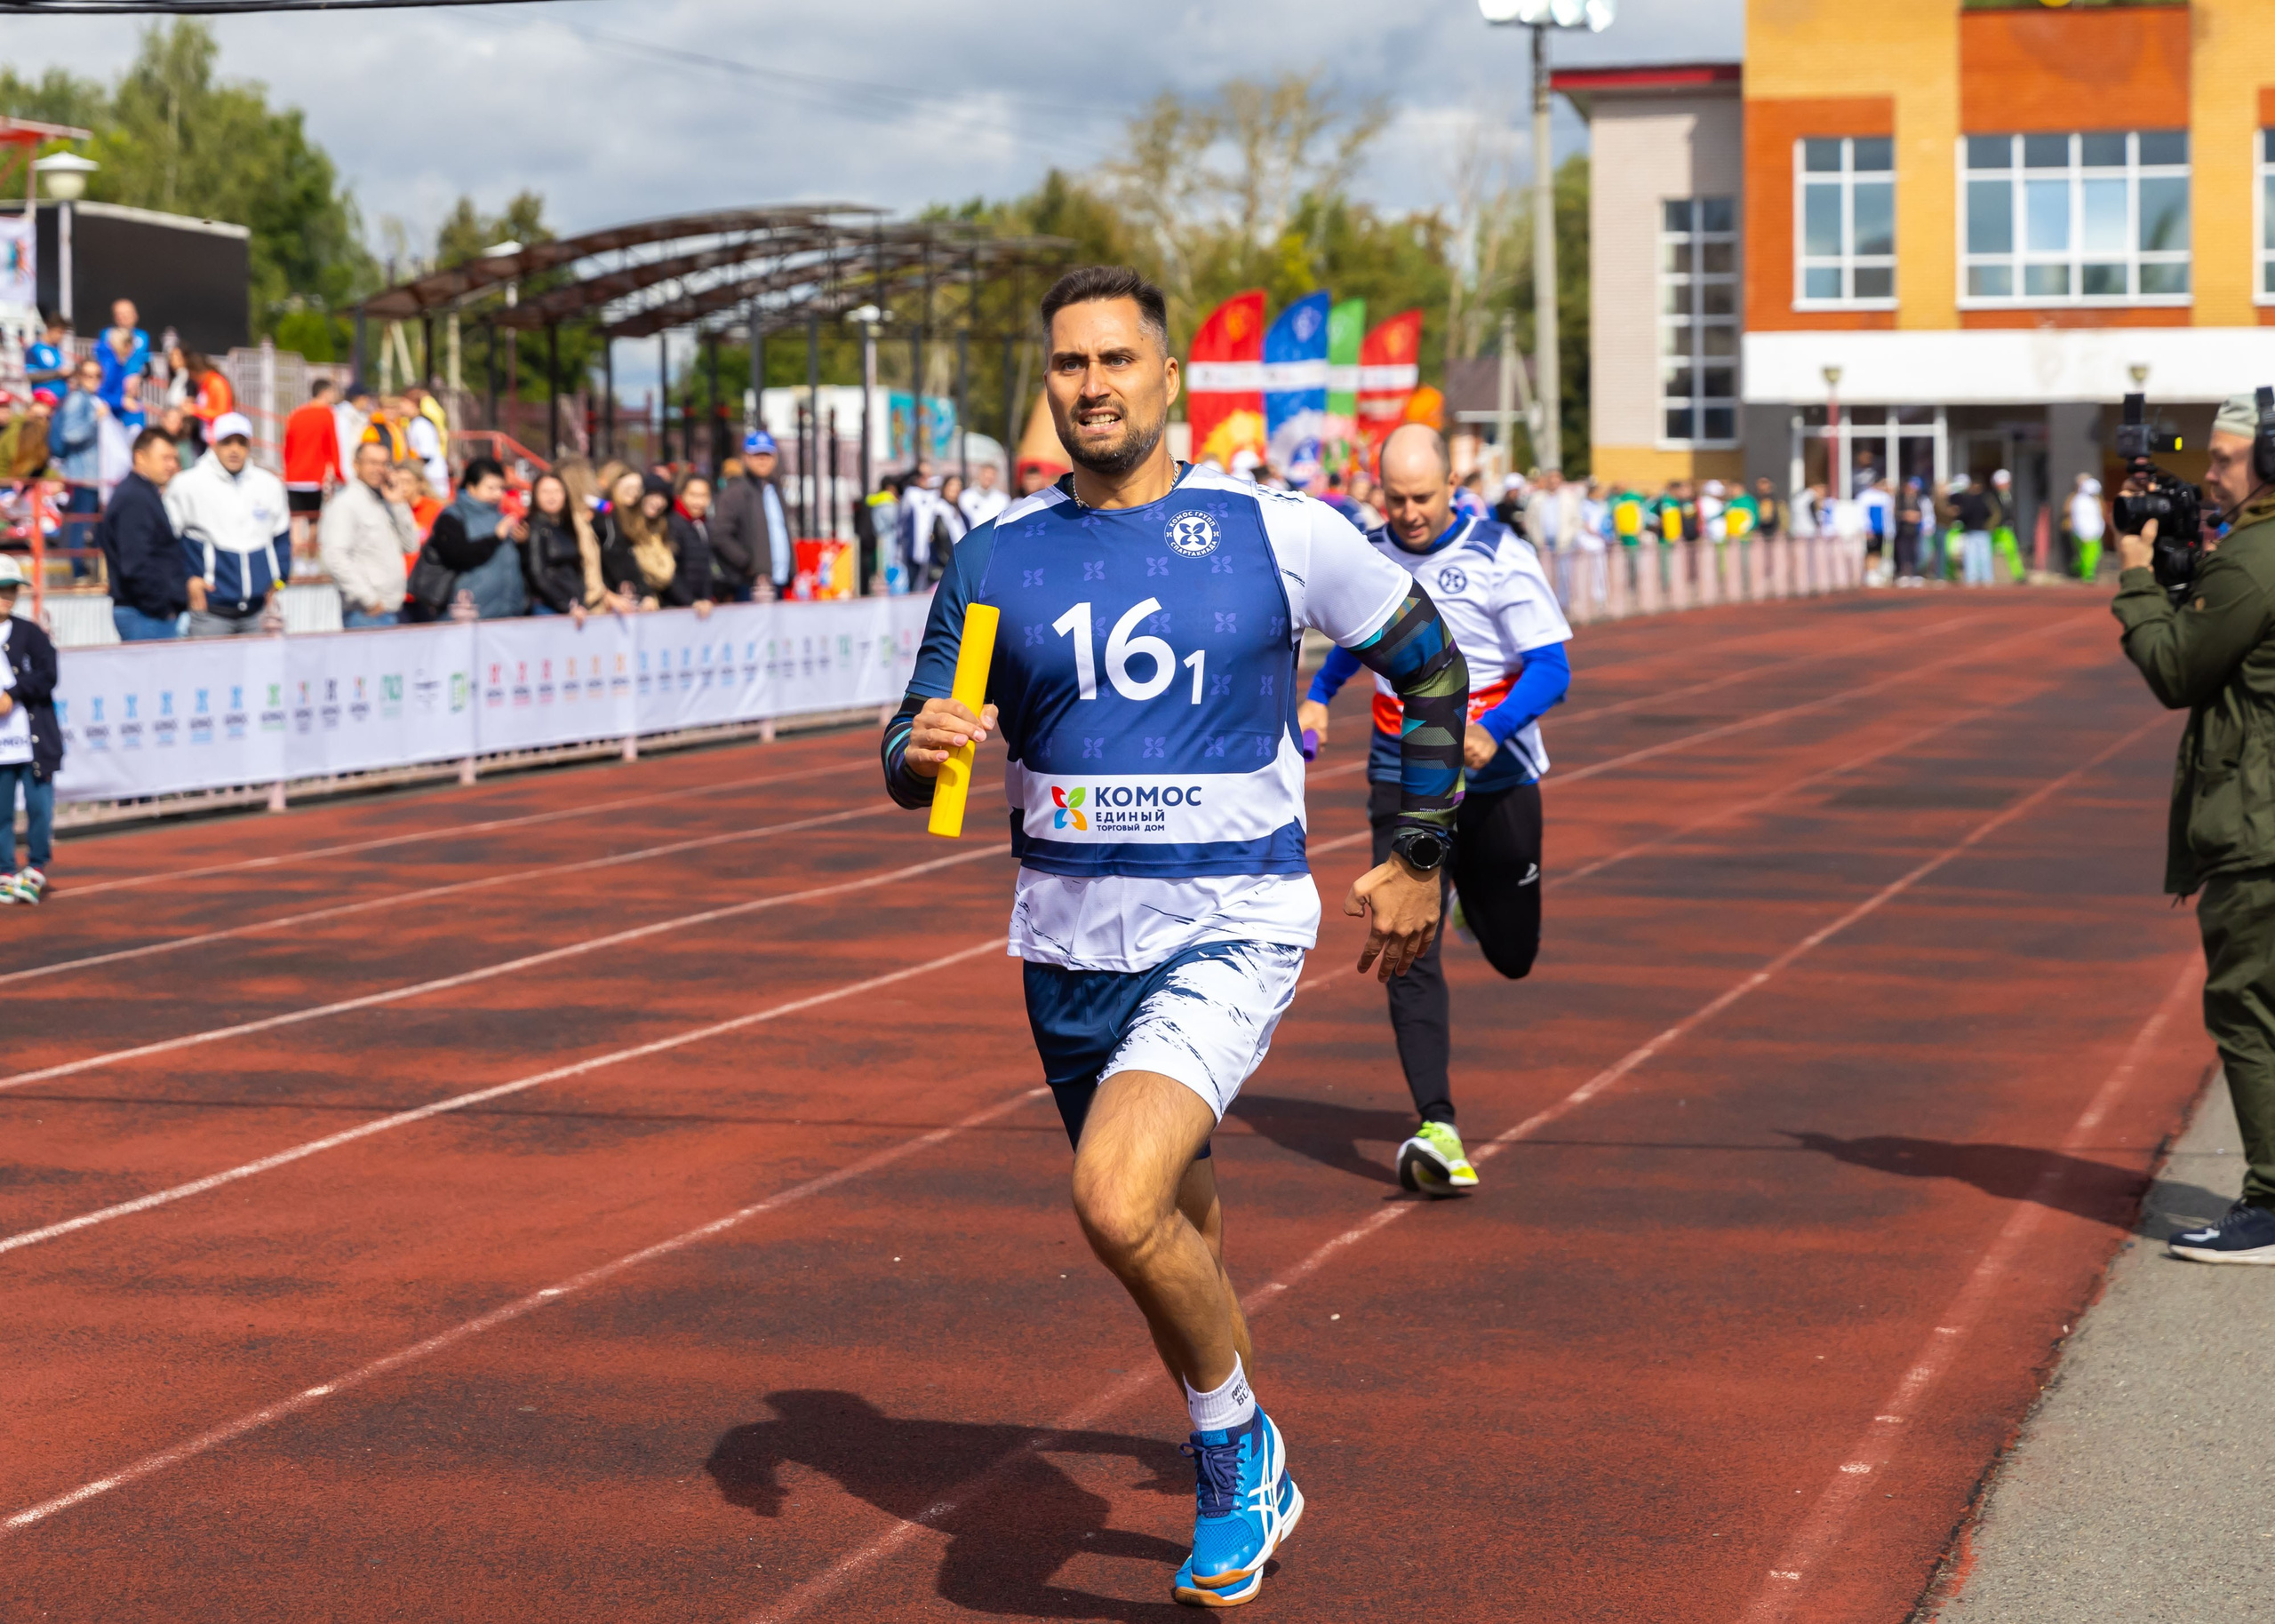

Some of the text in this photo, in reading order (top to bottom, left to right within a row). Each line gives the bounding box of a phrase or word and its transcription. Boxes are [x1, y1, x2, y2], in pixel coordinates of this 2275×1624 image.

[1169, 511, 1216, 528] КОМОС ГРУПП
[1170, 541, 1218, 556] СПАРТАКИАДА
[1095, 786, 1202, 807] КОМОС
[1095, 809, 1165, 824] ЕДИНЫЙ
